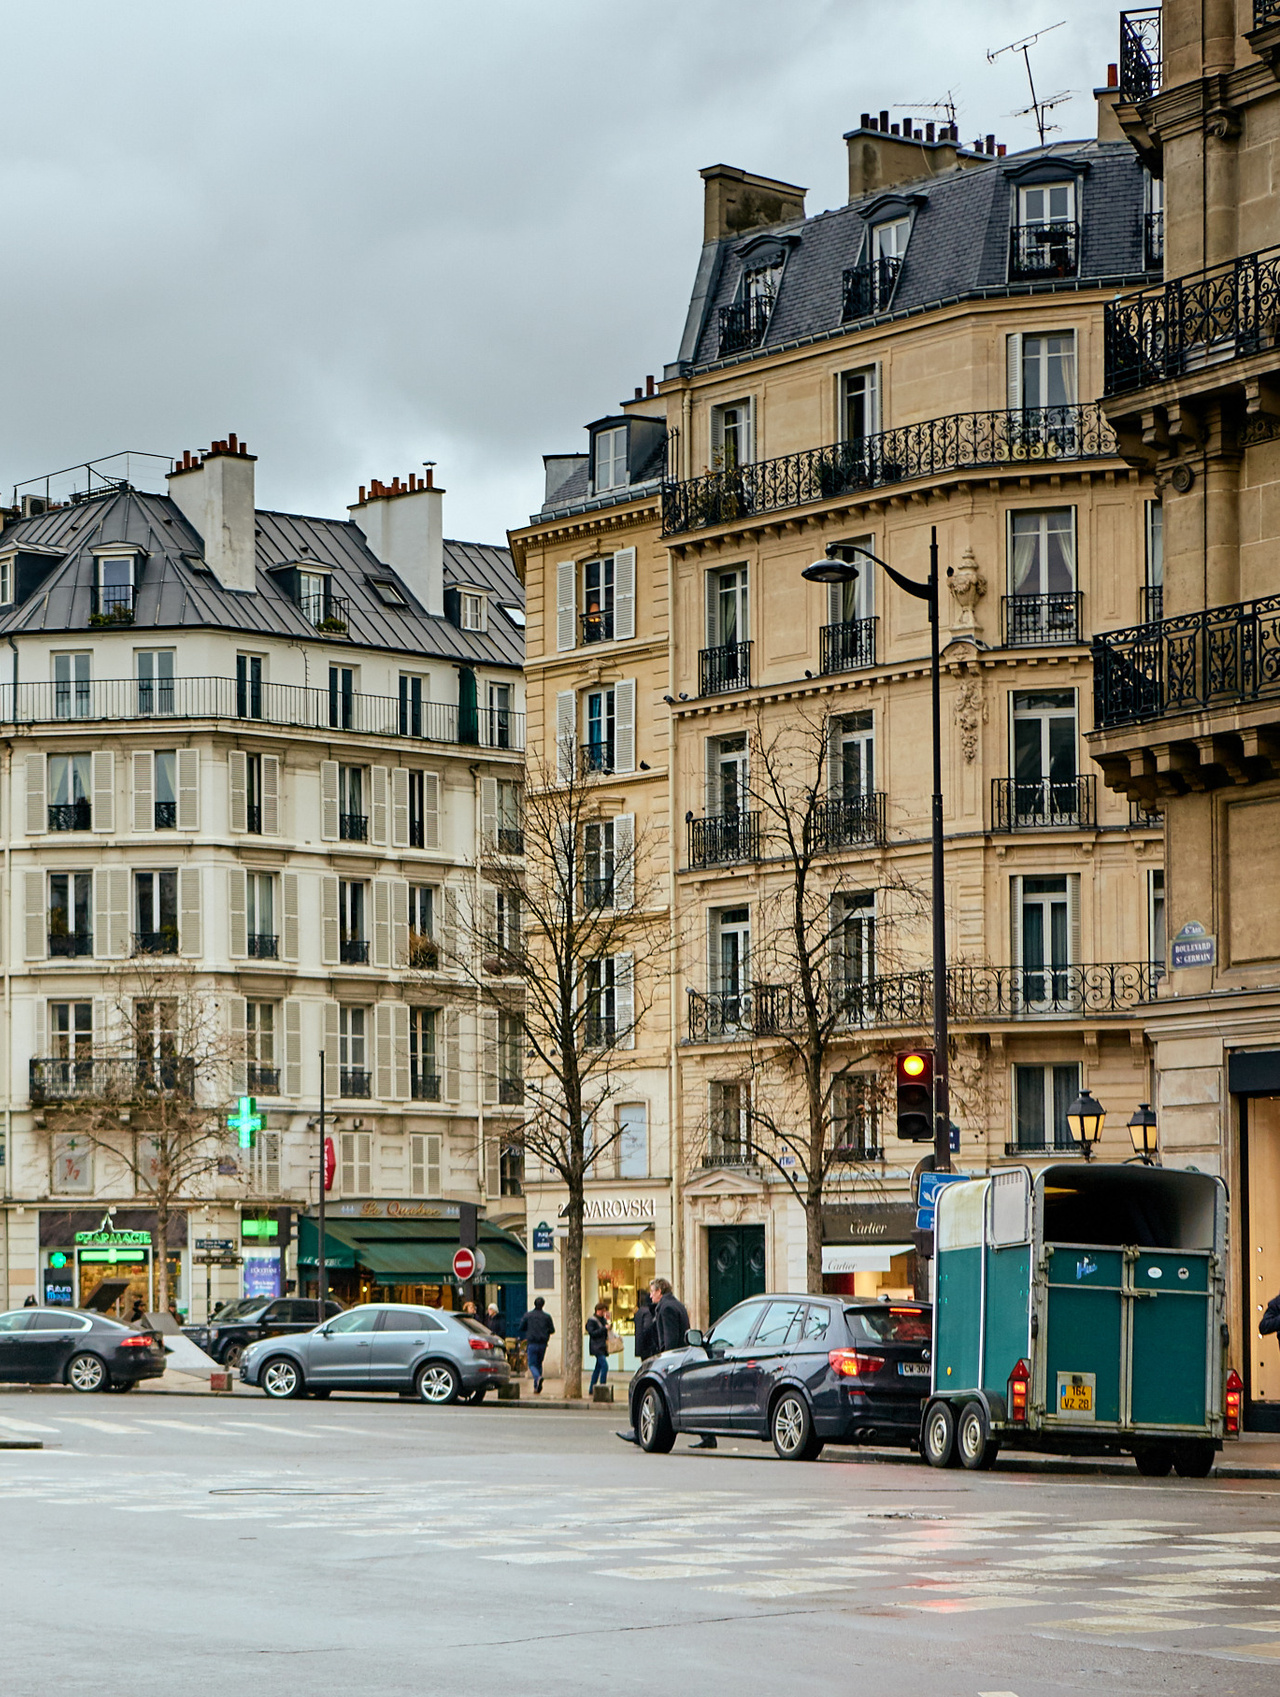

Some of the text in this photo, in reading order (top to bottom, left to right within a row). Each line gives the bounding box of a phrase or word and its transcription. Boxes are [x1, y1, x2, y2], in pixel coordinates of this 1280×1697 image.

[1175, 942, 1211, 954] BOULEVARD
[1183, 953, 1211, 963] GERMAIN
[583, 1199, 655, 1218] WAROVSKI
[850, 1219, 887, 1234] Cartier
[75, 1232, 152, 1244] PHARMACIE
[828, 1260, 857, 1270] Cartier
[46, 1284, 71, 1293] Futura
[1072, 1385, 1086, 1396] 164
[1064, 1398, 1075, 1408] VZ
